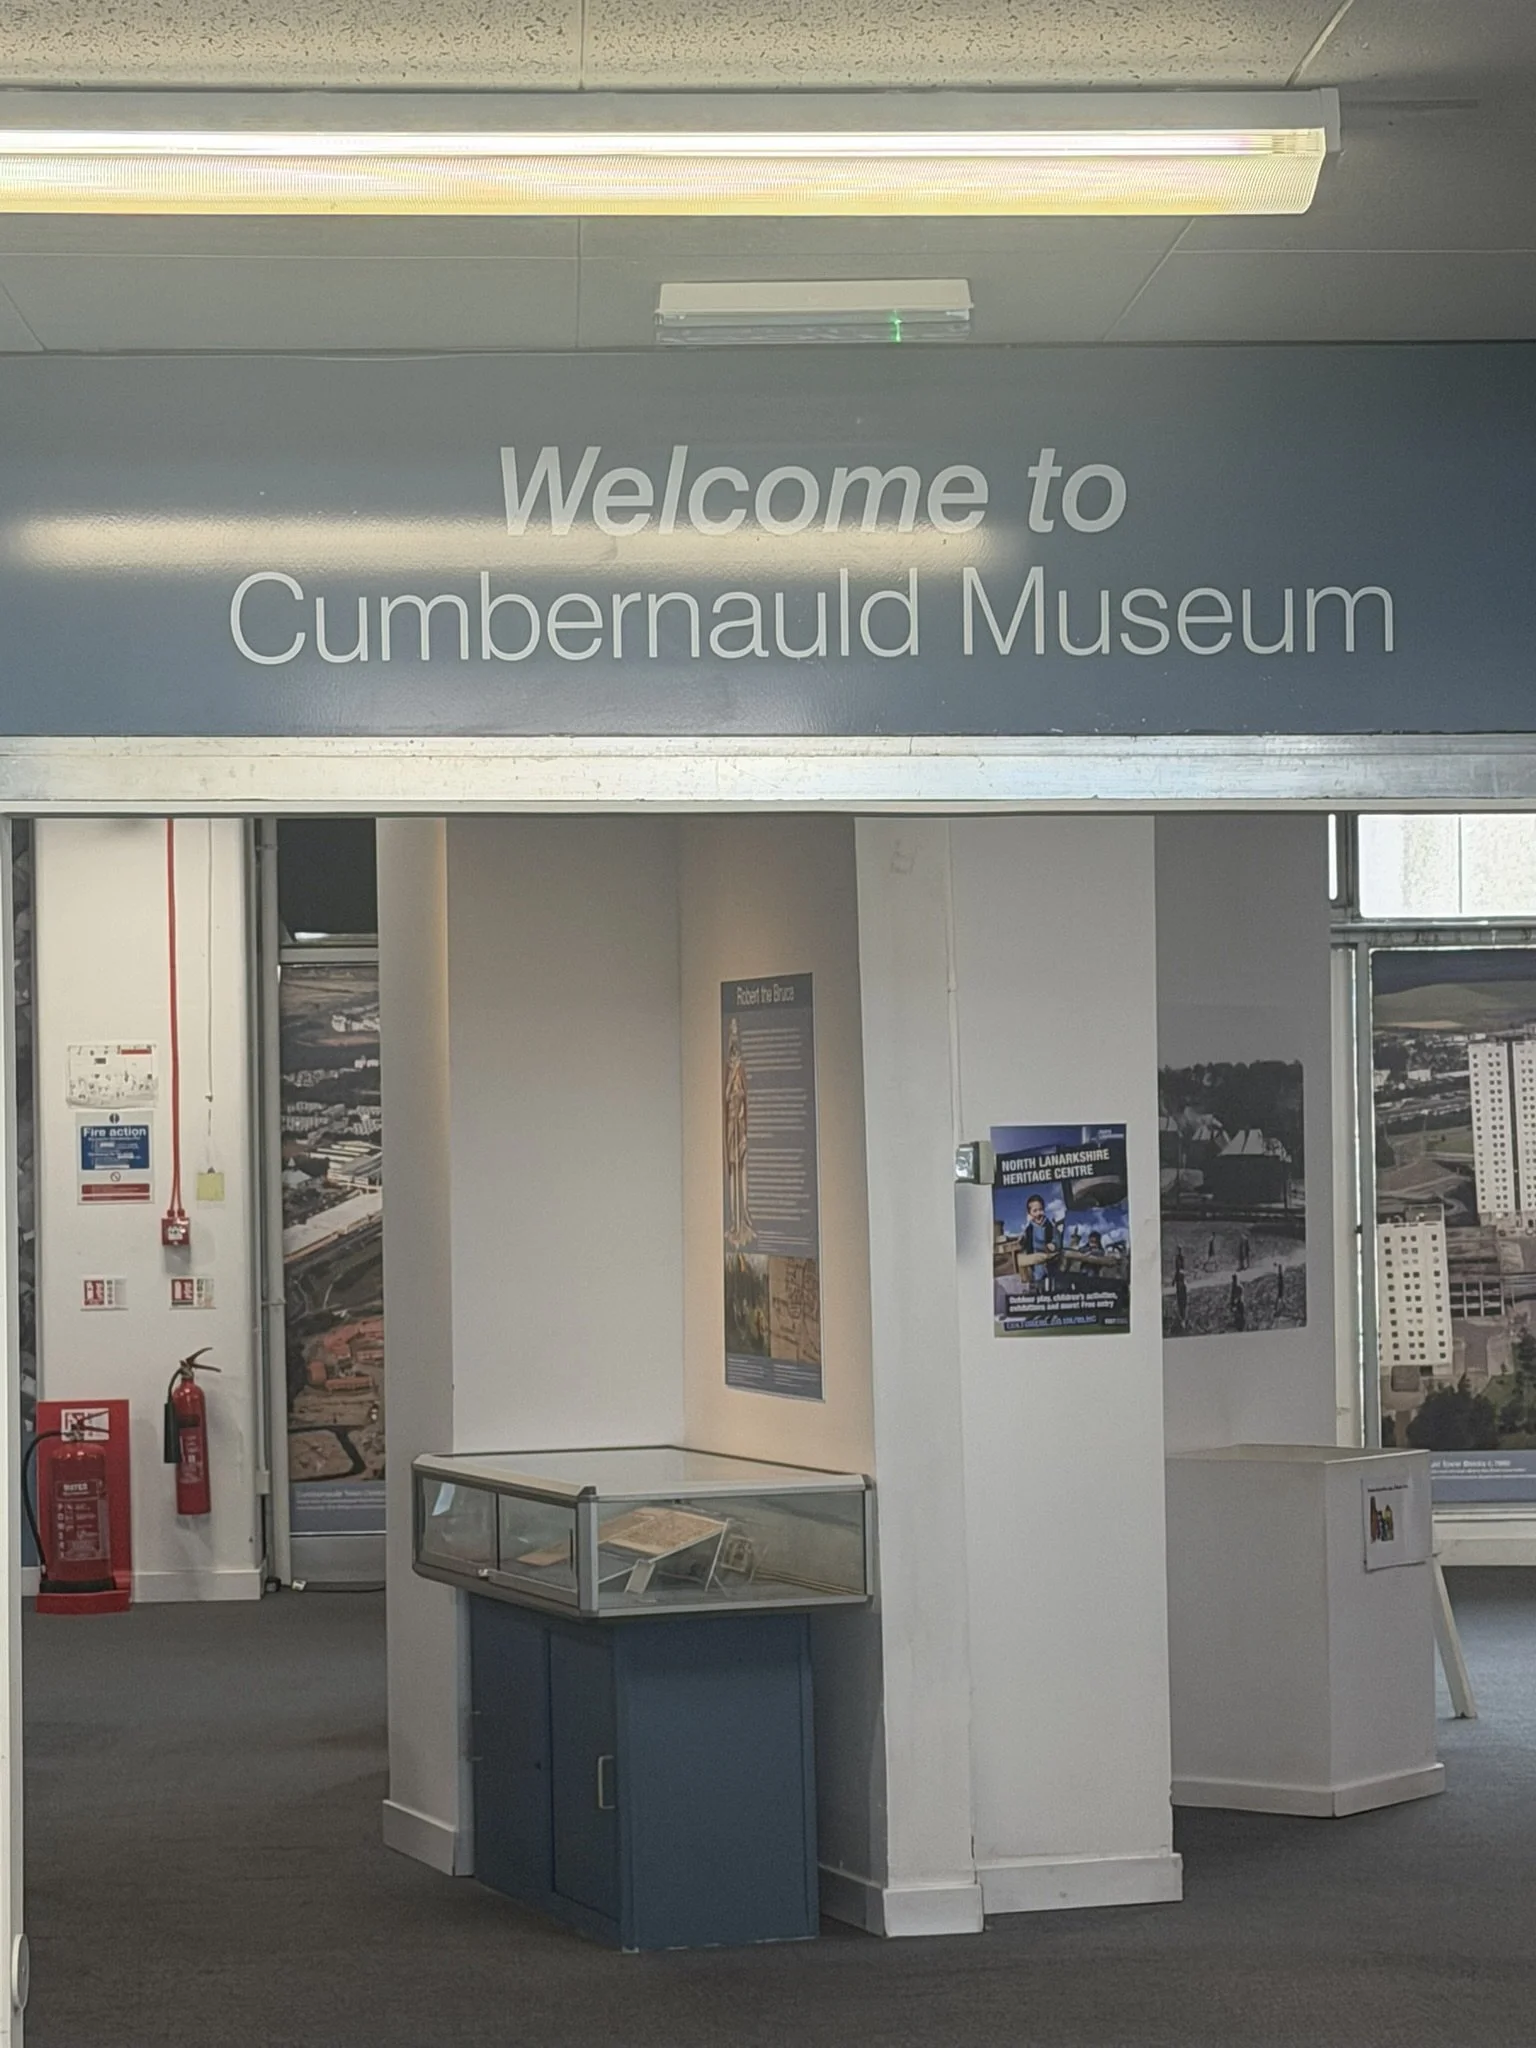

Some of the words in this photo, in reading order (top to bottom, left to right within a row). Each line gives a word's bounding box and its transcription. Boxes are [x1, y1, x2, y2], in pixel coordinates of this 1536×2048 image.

[500, 445, 989, 537] Welcome
[1027, 448, 1127, 533] to
[229, 568, 921, 665] Cumbernauld
[963, 566, 1396, 656] Museum
[83, 1127, 106, 1137] Fire
[109, 1126, 147, 1136] action
[1001, 1157, 1036, 1172] NORTH
[1039, 1148, 1110, 1167] LANARKSHIRE
[1002, 1169, 1052, 1185] HERITAGE
[1054, 1164, 1094, 1179] CENTRE
